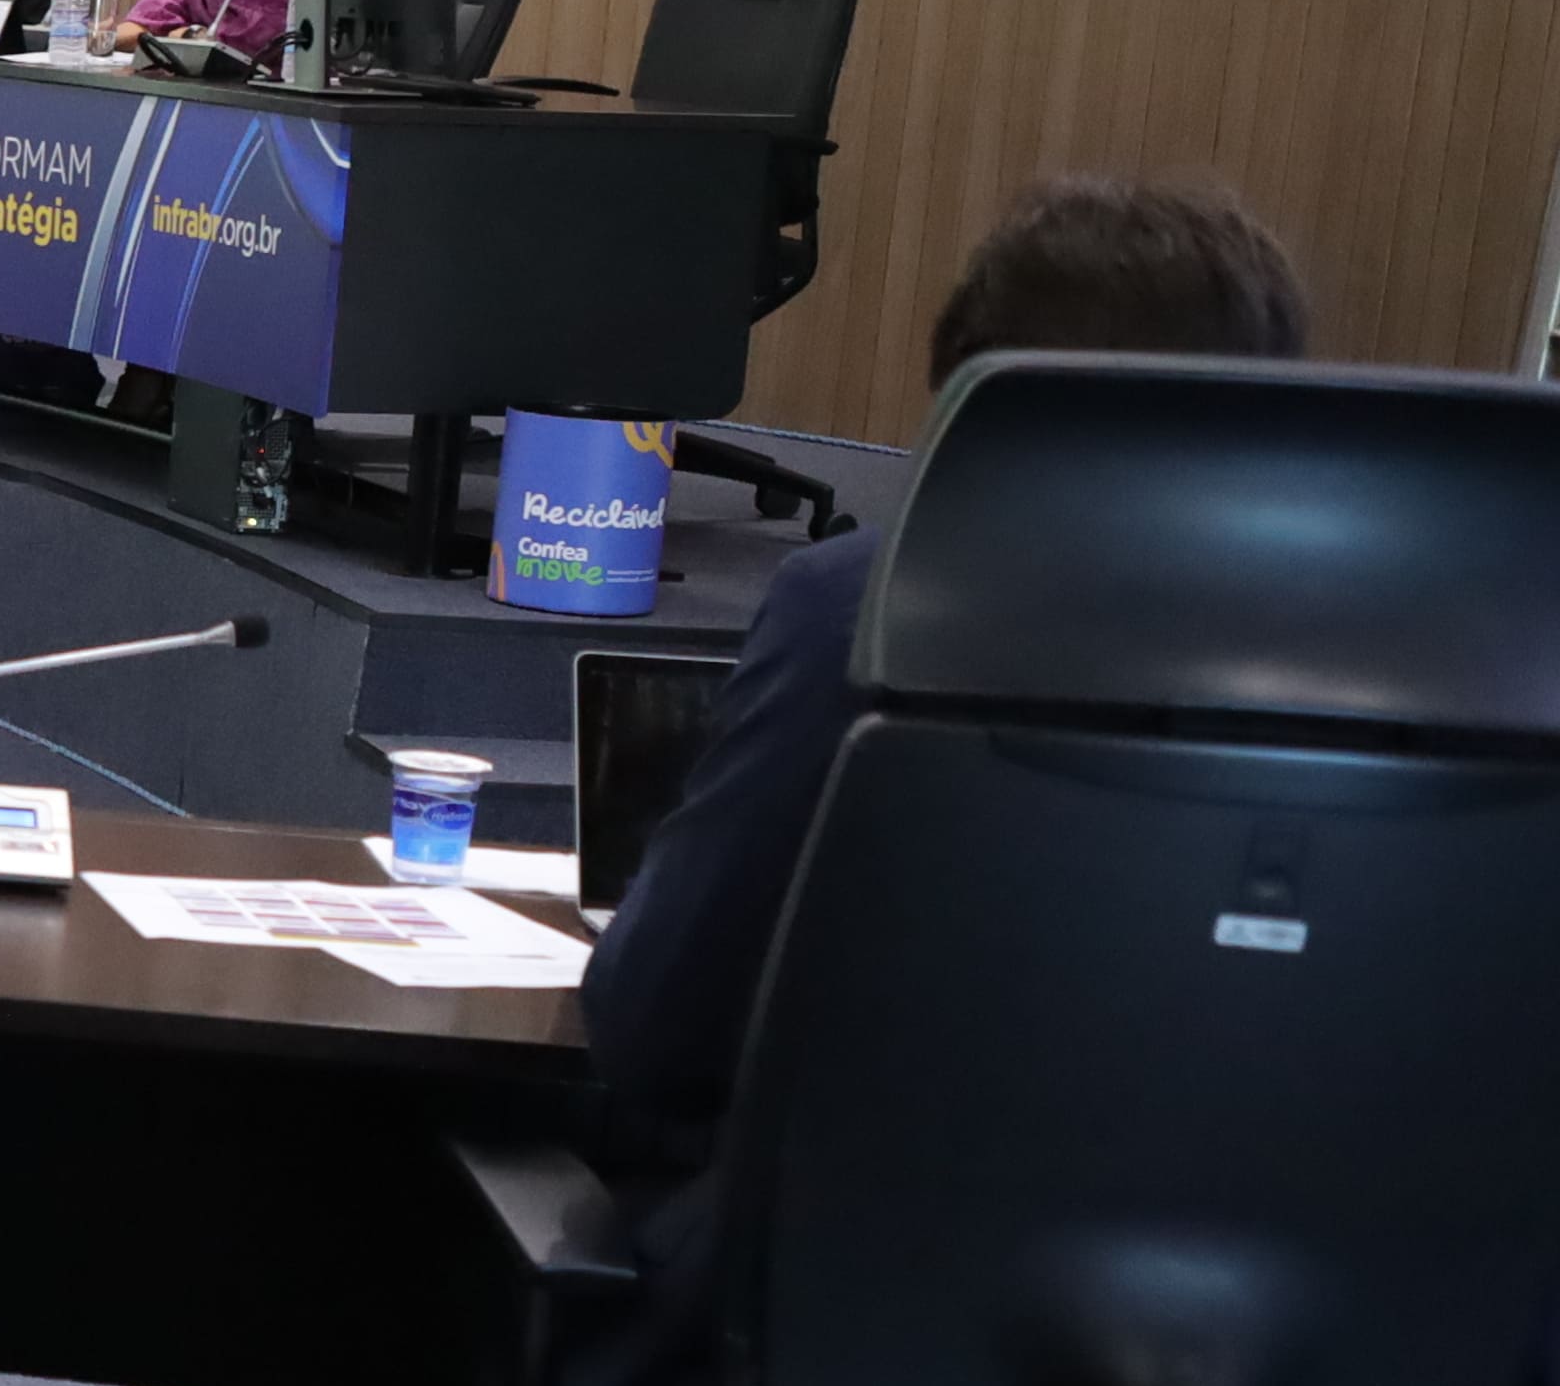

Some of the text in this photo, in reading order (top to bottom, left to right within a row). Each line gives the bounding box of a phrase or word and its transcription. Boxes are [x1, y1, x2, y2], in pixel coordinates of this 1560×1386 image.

[153, 195, 281, 257] infrabr.org.br
[518, 537, 588, 561] Confea
[516, 556, 604, 586] move
